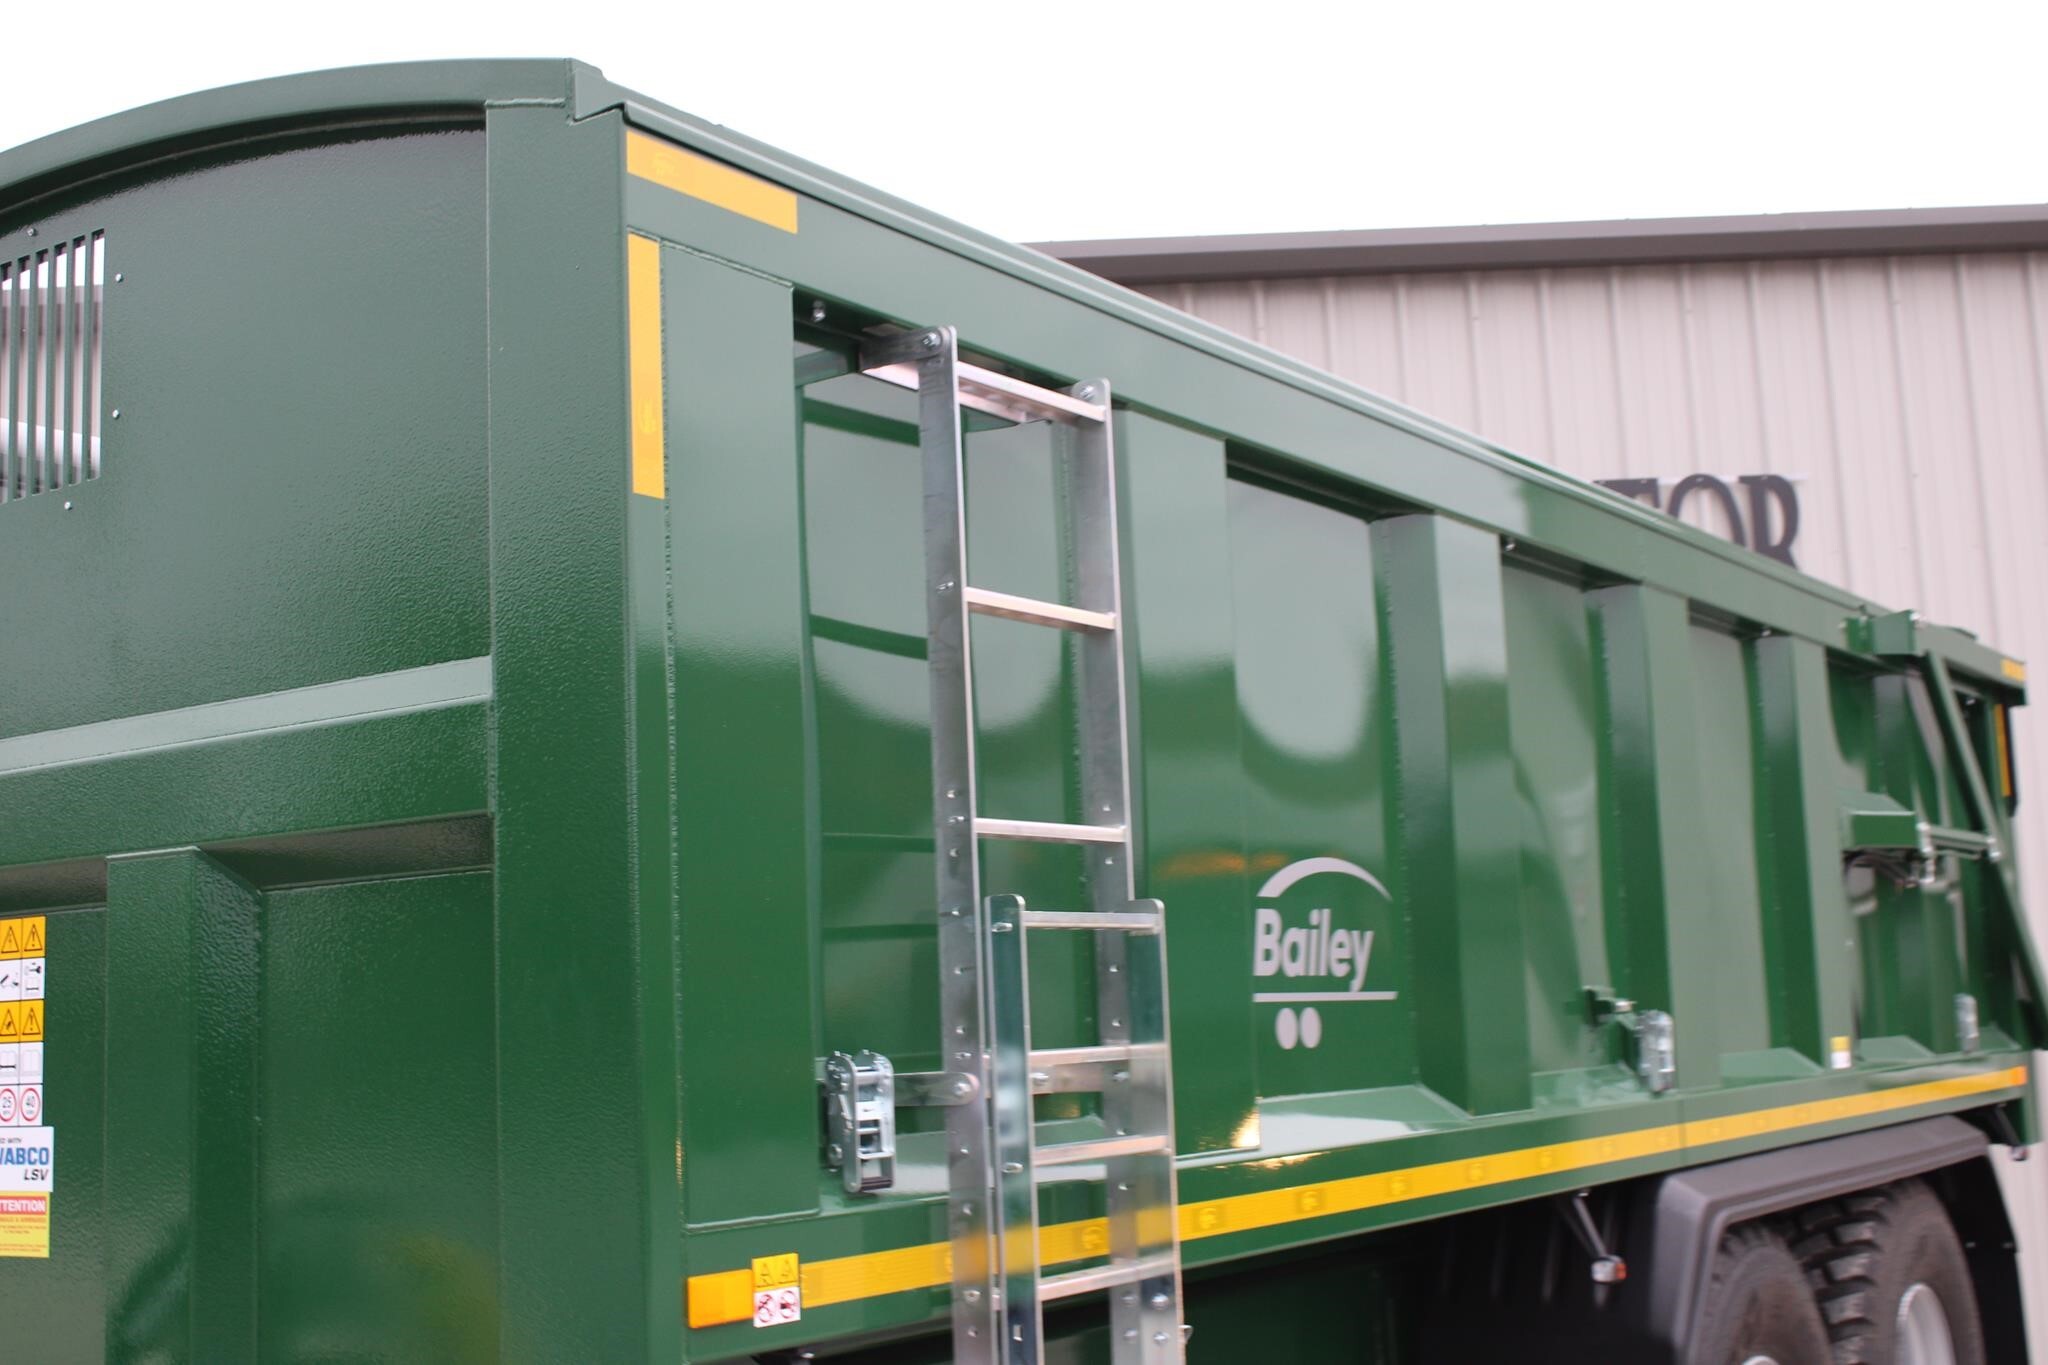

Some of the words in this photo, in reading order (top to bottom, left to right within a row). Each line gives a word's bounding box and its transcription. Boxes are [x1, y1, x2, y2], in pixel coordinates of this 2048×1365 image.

[1253, 908, 1375, 993] Bailey
[0, 1147, 50, 1165] ABCO
[24, 1168, 49, 1181] LSV
